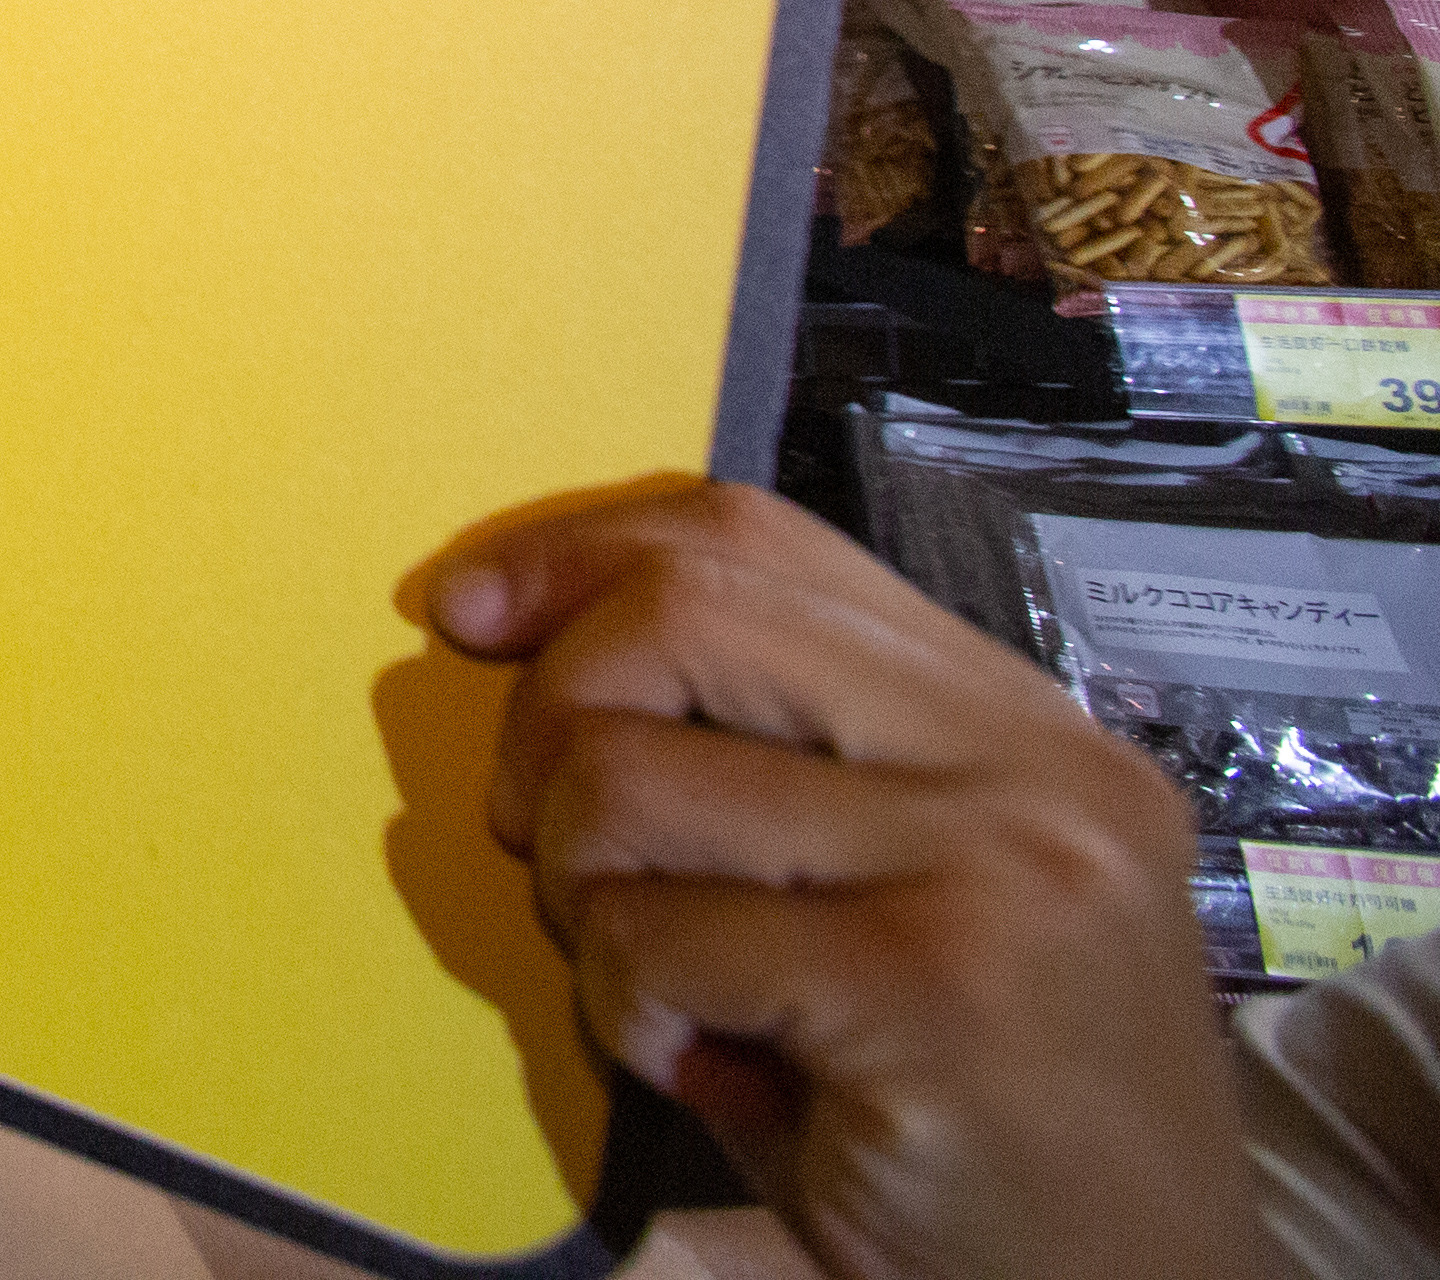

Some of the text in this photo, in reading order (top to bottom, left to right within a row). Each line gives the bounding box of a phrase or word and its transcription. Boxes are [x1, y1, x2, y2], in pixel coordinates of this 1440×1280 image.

[1085, 579, 1381, 627] ミルクココアキャンディー
